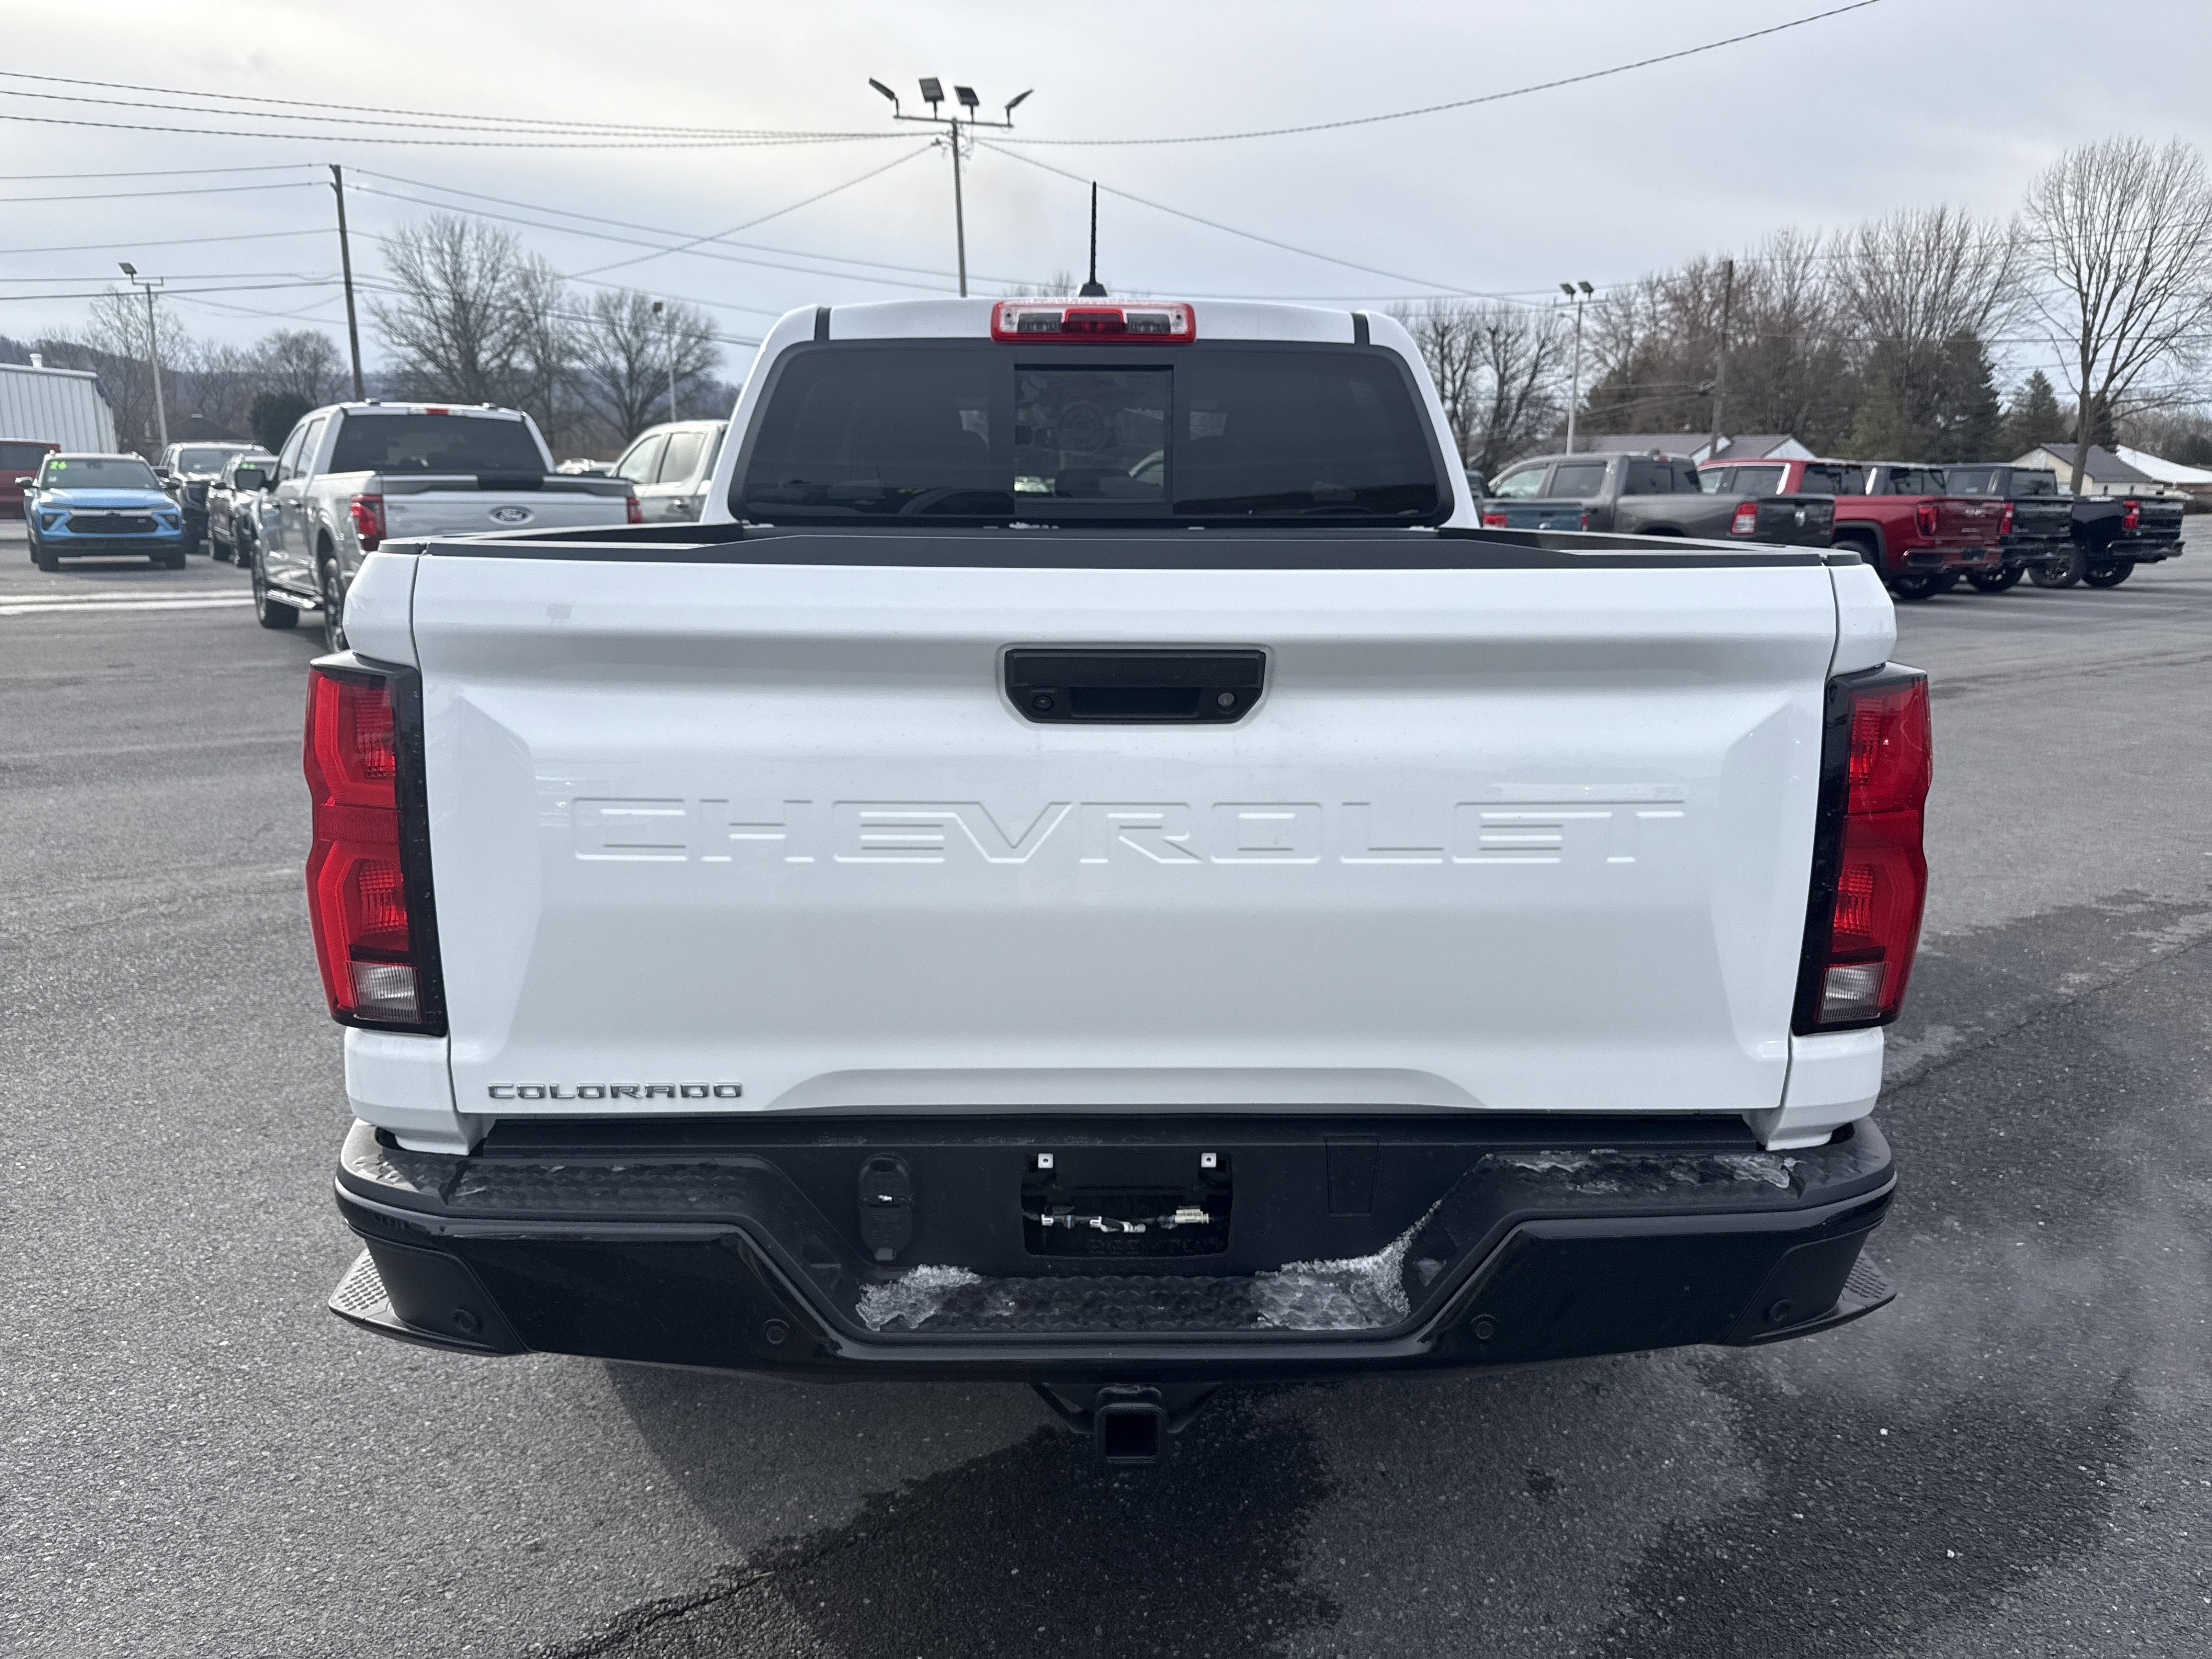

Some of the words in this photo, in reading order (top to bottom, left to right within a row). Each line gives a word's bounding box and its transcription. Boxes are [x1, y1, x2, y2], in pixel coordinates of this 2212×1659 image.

[49, 461, 67, 470] 26
[572, 798, 1685, 864] CHEVROLET
[487, 1082, 743, 1099] COLORADO
